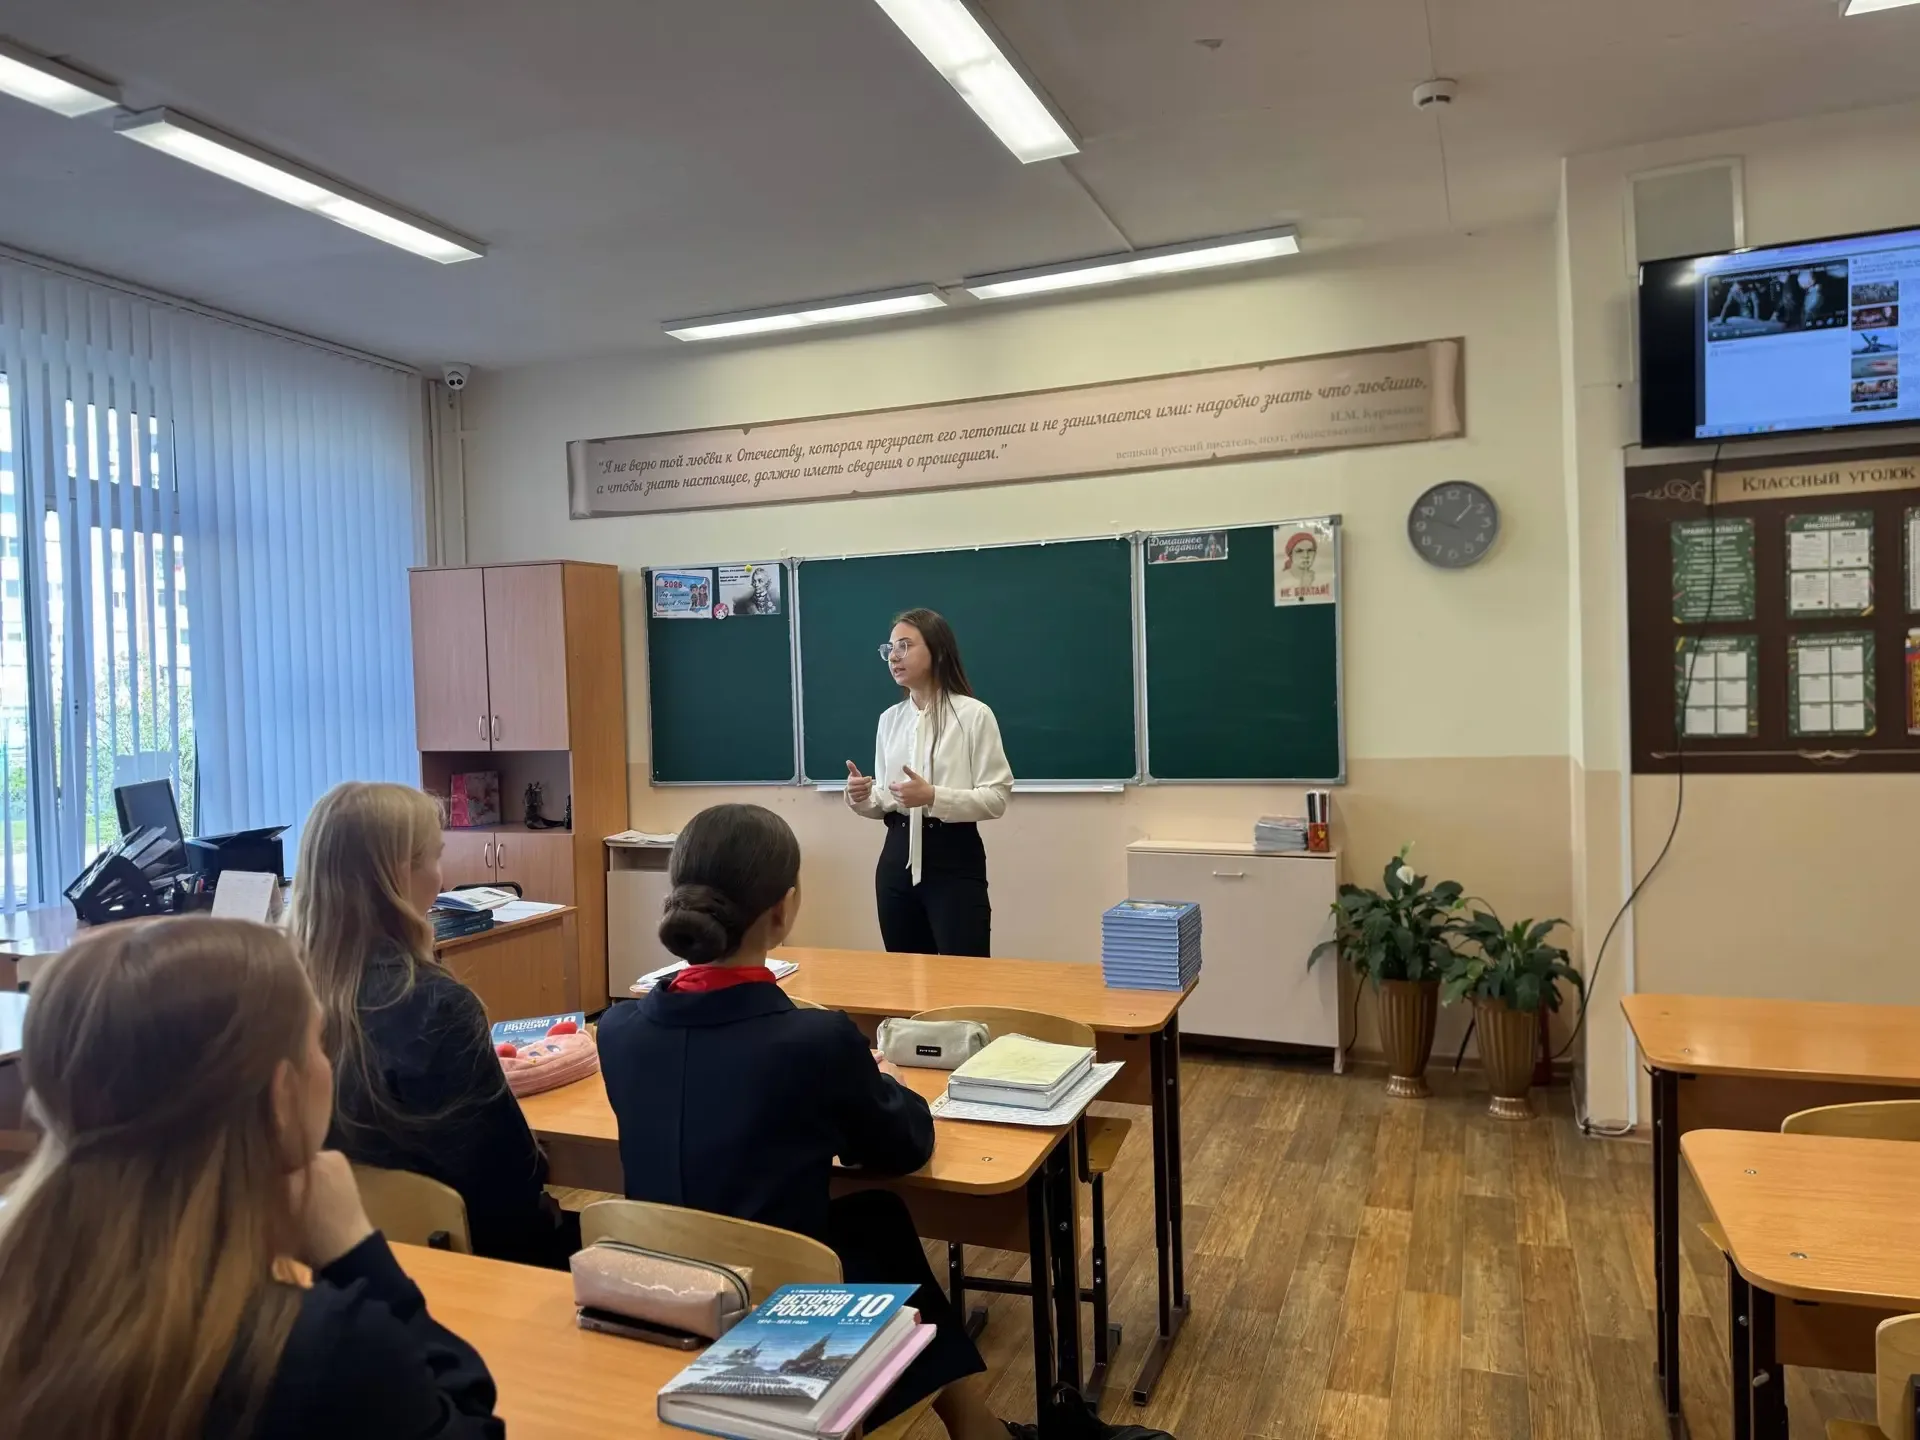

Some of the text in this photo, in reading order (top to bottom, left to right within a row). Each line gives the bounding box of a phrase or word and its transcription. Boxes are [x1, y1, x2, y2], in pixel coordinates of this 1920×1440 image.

[613, 462, 626, 472] не
[628, 459, 657, 476] верю
[660, 455, 683, 469] той
[686, 451, 722, 466] любви
[725, 453, 732, 463] к
[736, 444, 805, 463] Отечеству,
[808, 441, 863, 458] которая
[866, 432, 934, 454] презирает
[937, 430, 957, 442] его
[959, 422, 1026, 440] летописи
[1029, 421, 1039, 432] и
[1042, 418, 1058, 431] не
[1059, 408, 1152, 436] занимается
[1156, 404, 1193, 418] ими:
[1195, 394, 1259, 418] надобно
[1260, 390, 1312, 413] знать
[1318, 387, 1350, 399] что
[1353, 376, 1428, 396] любишь,
[1116, 446, 1158, 460] великий
[1161, 440, 1204, 457] русский
[596, 485, 603, 495] а
[607, 479, 643, 494] чтобы
[644, 479, 679, 496] знать
[682, 473, 750, 488] настоящее,
[754, 468, 800, 488] должно
[803, 465, 844, 478] иметь
[847, 458, 903, 478] сведения
[906, 456, 914, 468] о
[1433, 495, 1443, 505] 11
[1446, 490, 1460, 500] 12
[1150, 536, 1202, 547] Домашнее
[1164, 543, 1204, 555] задание
[1280, 588, 1292, 598] НЕ
[779, 1293, 855, 1305] ИСТОРИЯ
[766, 1304, 844, 1317] РОССИИ
[846, 1293, 895, 1318] 10
